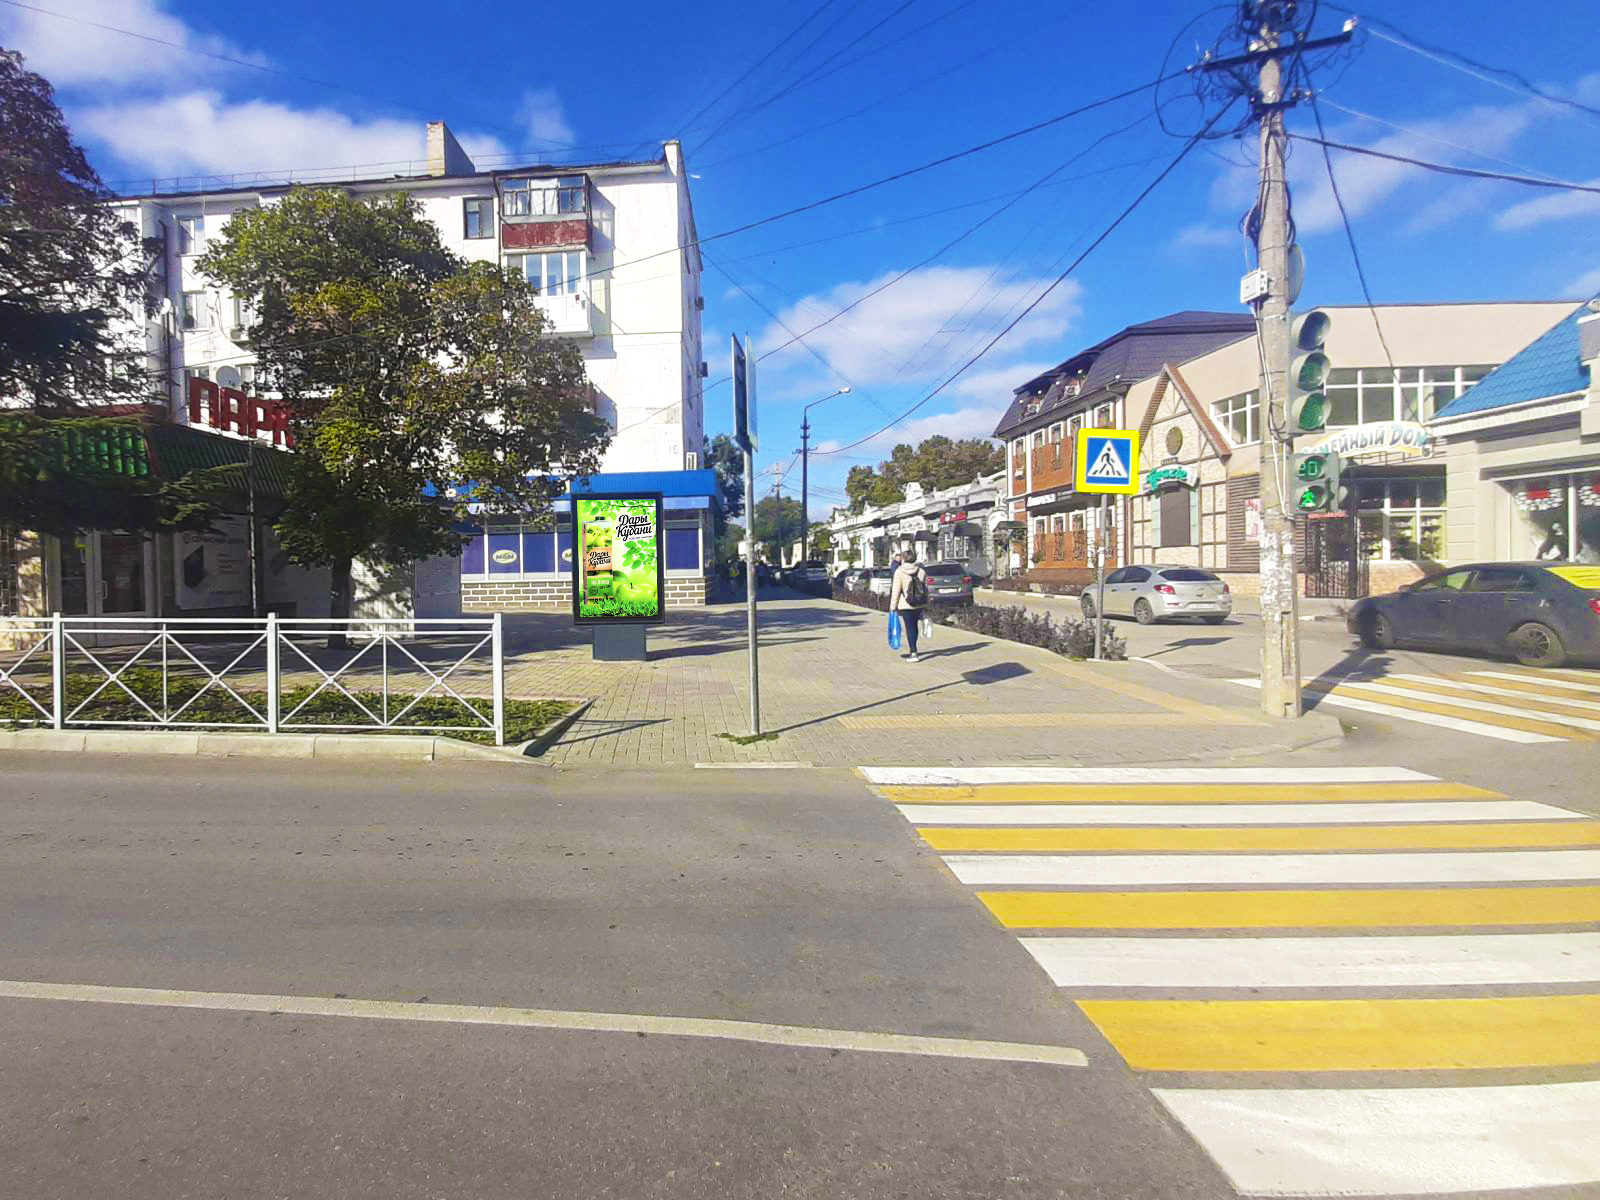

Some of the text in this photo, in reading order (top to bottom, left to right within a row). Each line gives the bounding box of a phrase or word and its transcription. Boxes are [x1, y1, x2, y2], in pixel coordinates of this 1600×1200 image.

[190, 376, 295, 449] ПАРК
[618, 514, 651, 528] Дары
[616, 525, 652, 541] Кубани
